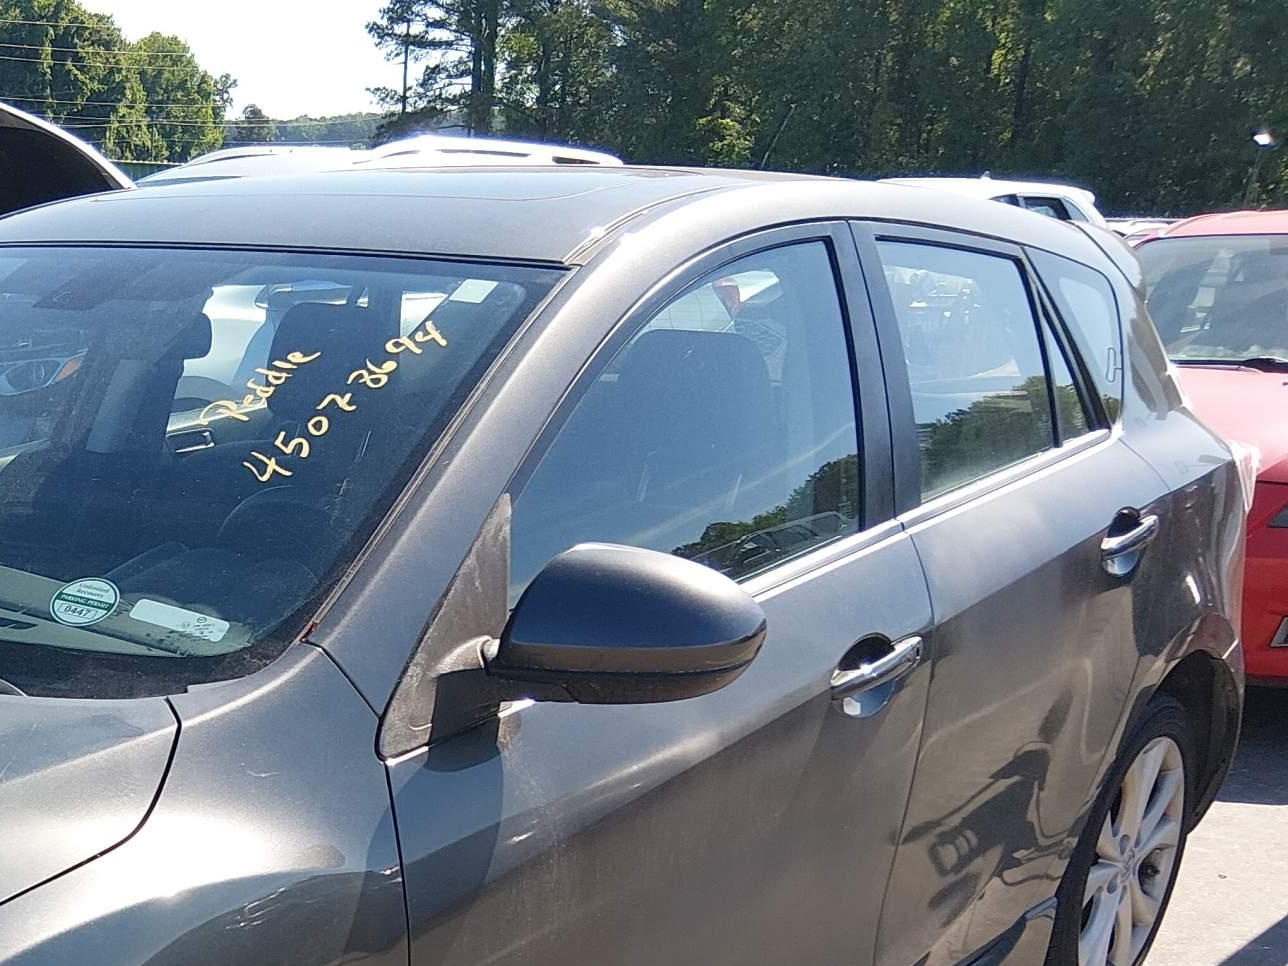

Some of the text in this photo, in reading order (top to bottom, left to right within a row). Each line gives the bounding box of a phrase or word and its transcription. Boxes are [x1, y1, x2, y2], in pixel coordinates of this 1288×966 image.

[59, 594, 110, 609] PARKING PERMIT
[63, 605, 91, 617] 0447
